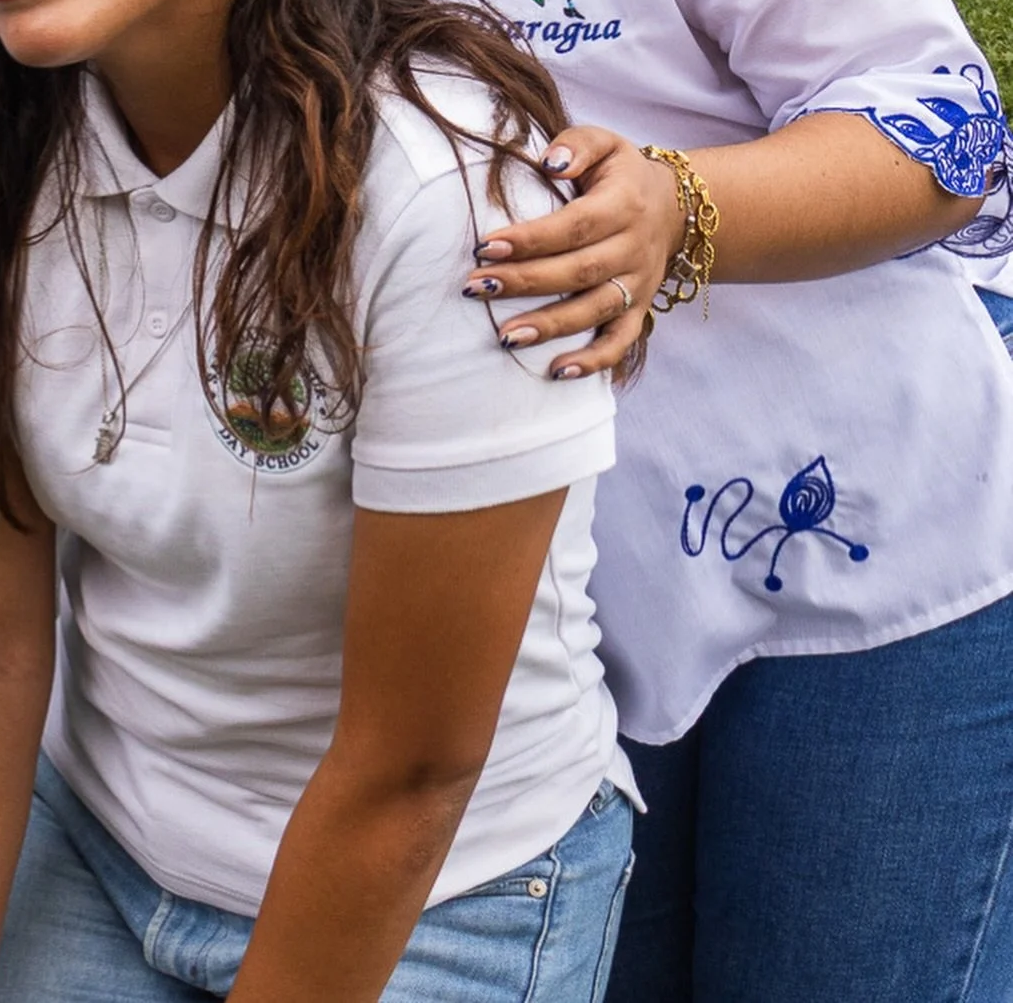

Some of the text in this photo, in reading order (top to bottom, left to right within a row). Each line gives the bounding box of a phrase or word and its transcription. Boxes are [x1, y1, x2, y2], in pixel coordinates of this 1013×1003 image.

[507, 19, 622, 54] aragua
[218, 427, 320, 469] DAY SCHOOL
